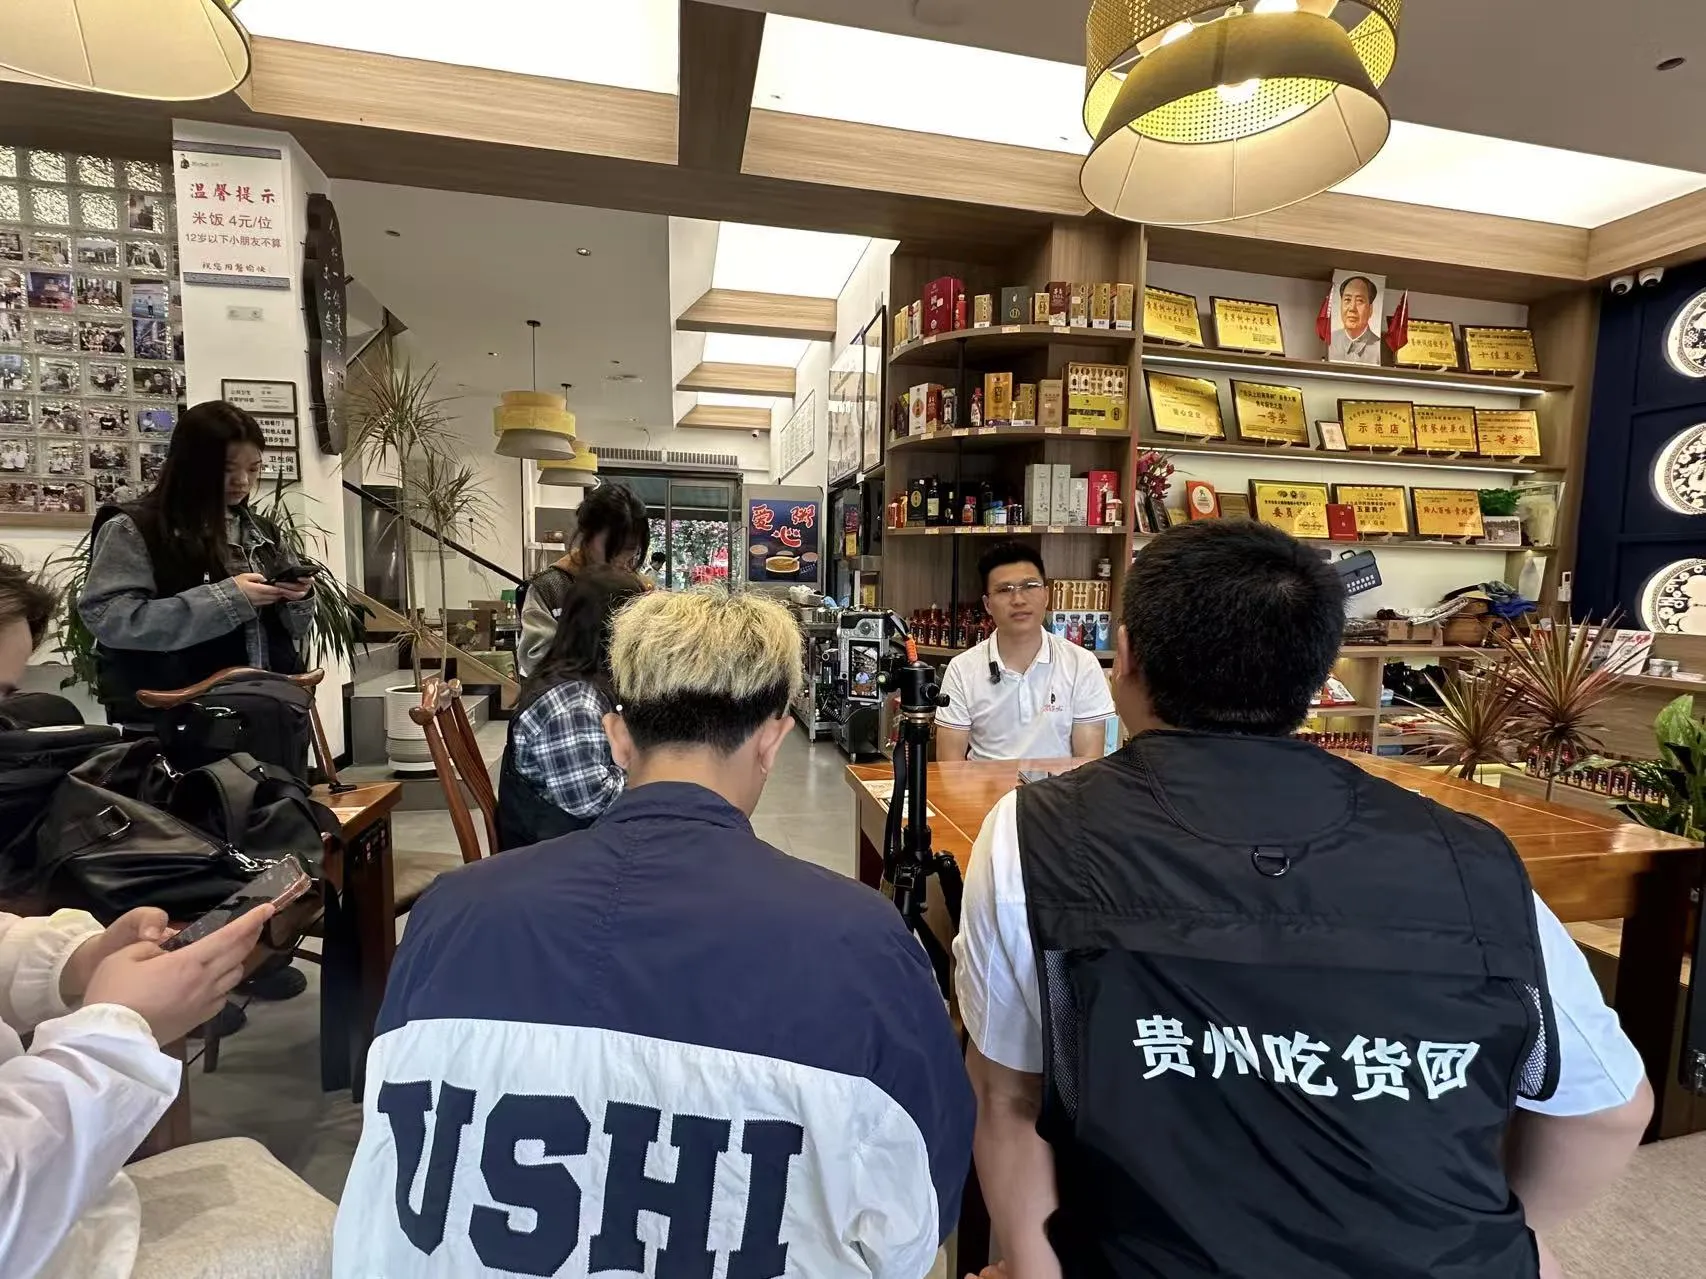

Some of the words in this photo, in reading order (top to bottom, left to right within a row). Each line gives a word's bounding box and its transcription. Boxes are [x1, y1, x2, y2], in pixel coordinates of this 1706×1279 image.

[190, 182, 275, 204] 温馨提示
[192, 211, 224, 227] 米饭
[229, 215, 273, 230] 4元/位
[185, 233, 282, 248] 12岁以下小朋友不算
[1256, 411, 1289, 425] 一等奖
[1358, 422, 1400, 435] 示范店
[1414, 424, 1468, 435] 信餐饮单位
[1479, 433, 1525, 445] 三等奖
[269, 455, 294, 464] 卫生间
[1133, 1014, 1480, 1101] 贵州吃货团
